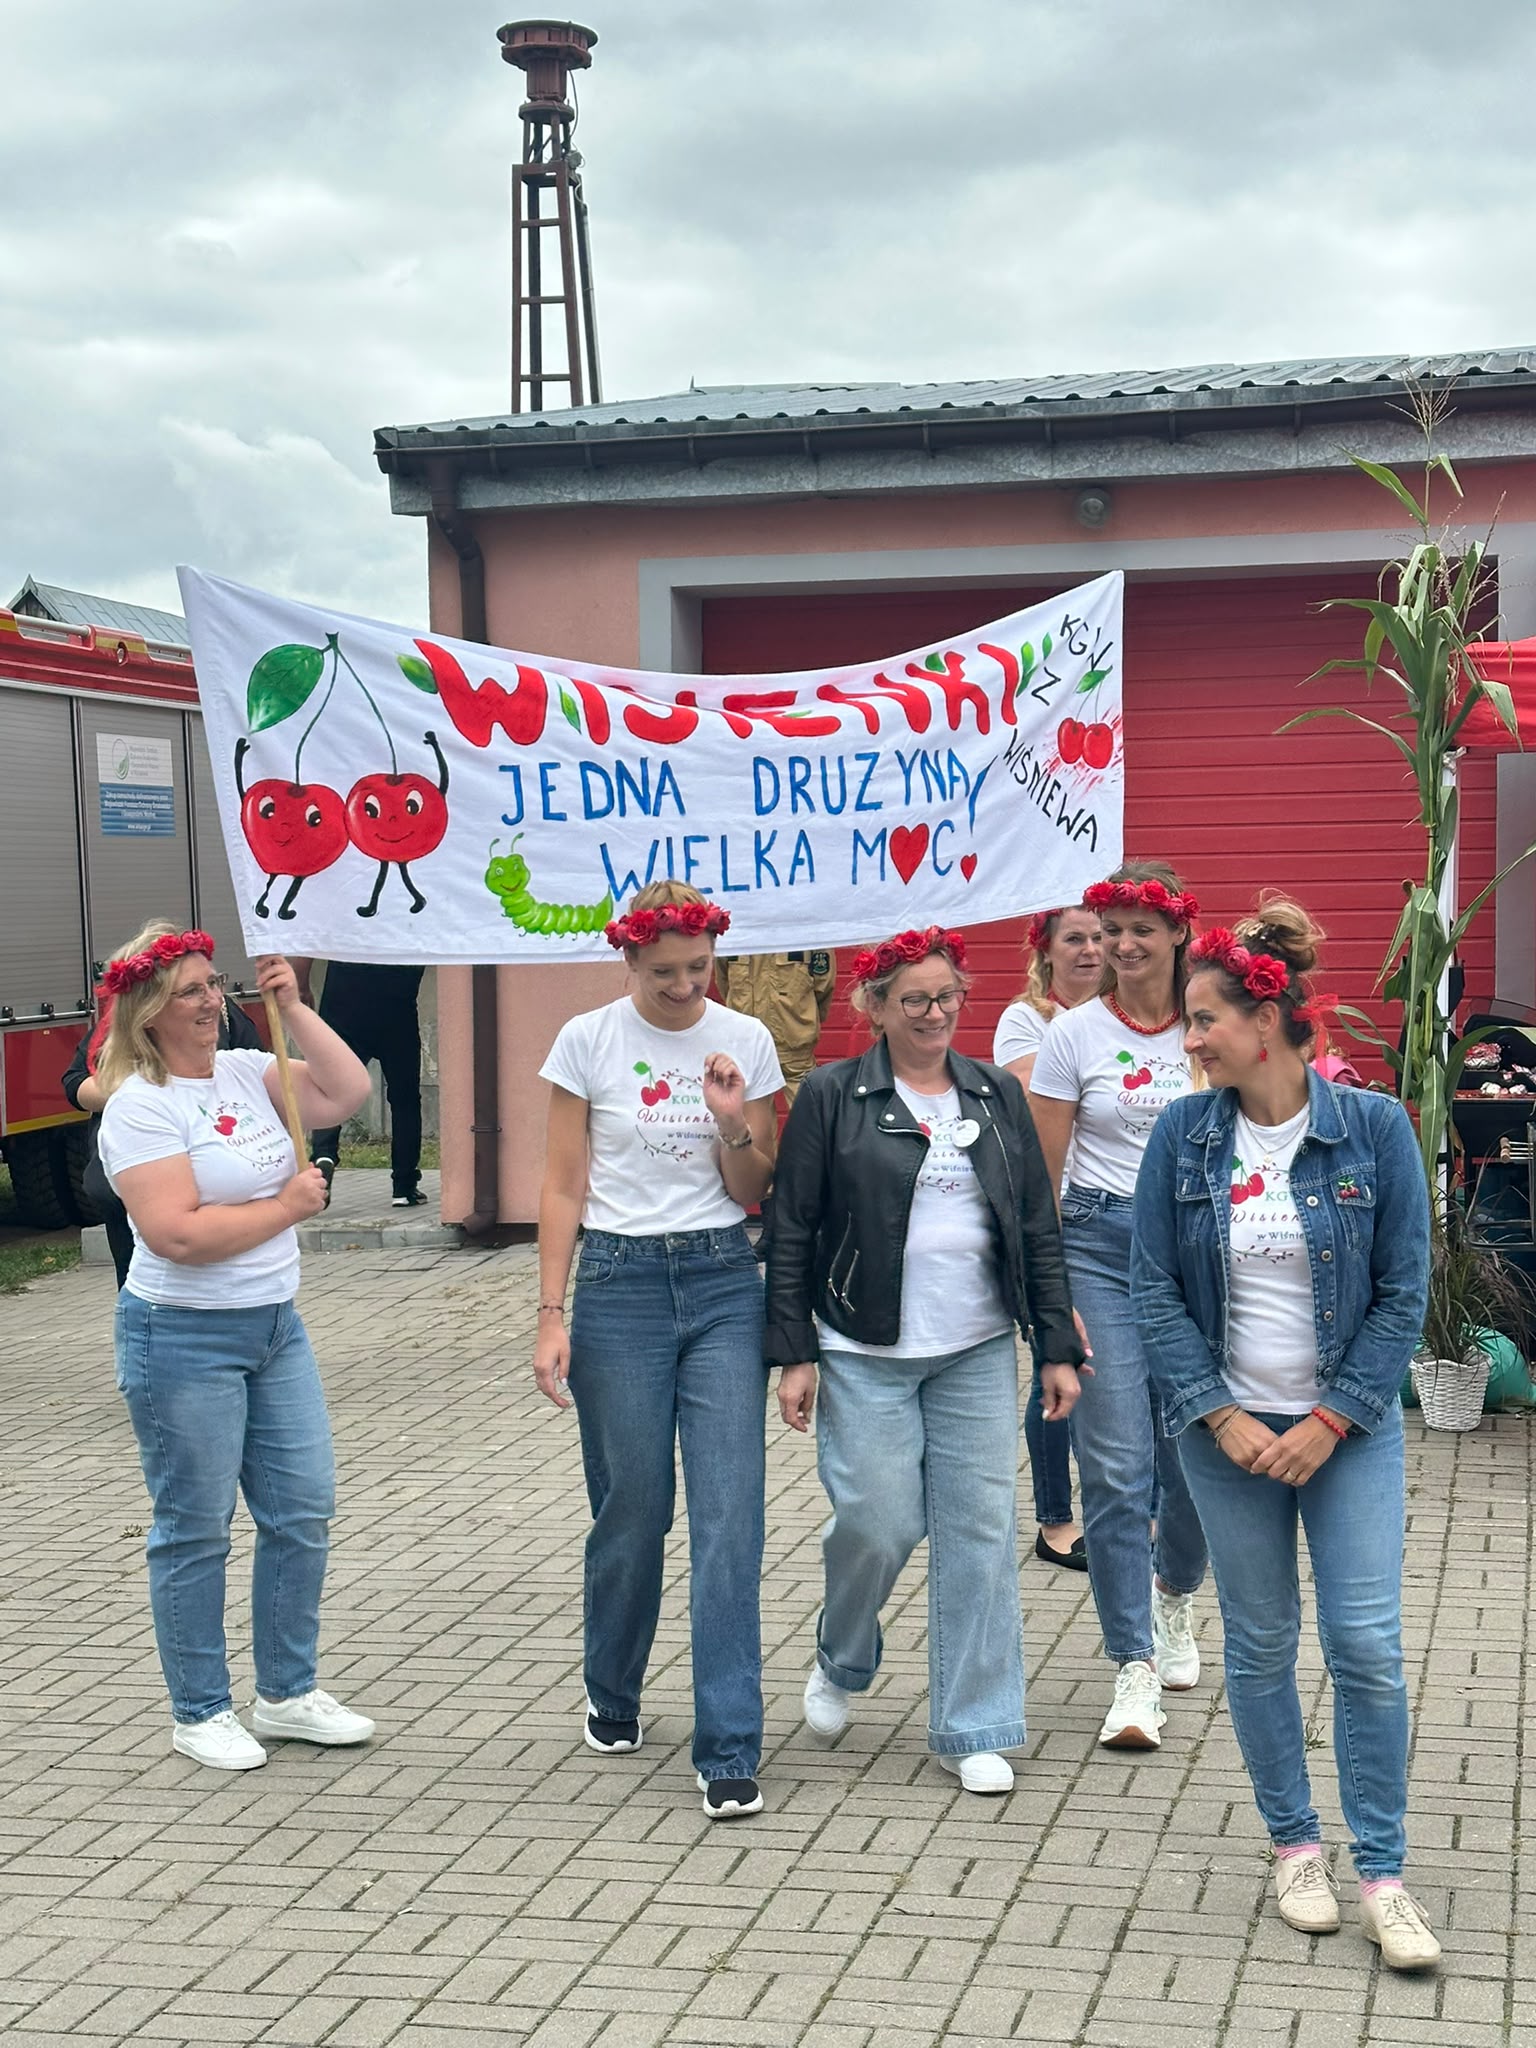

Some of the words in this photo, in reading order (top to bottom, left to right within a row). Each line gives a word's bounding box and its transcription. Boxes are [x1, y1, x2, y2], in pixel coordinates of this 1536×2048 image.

[499, 756, 686, 826] JEDNA
[1003, 727, 1097, 852] WIŚNIEWA
[600, 829, 815, 902] WIELKA
[1153, 1080, 1184, 1089] KGW
[671, 1094, 702, 1105] KGW
[1117, 1091, 1173, 1106] Wisie
[933, 1133, 953, 1142] KG
[1265, 1191, 1289, 1202] KG
[1230, 1206, 1300, 1223] Wisien
[1268, 1231, 1305, 1240] Wiśnie
